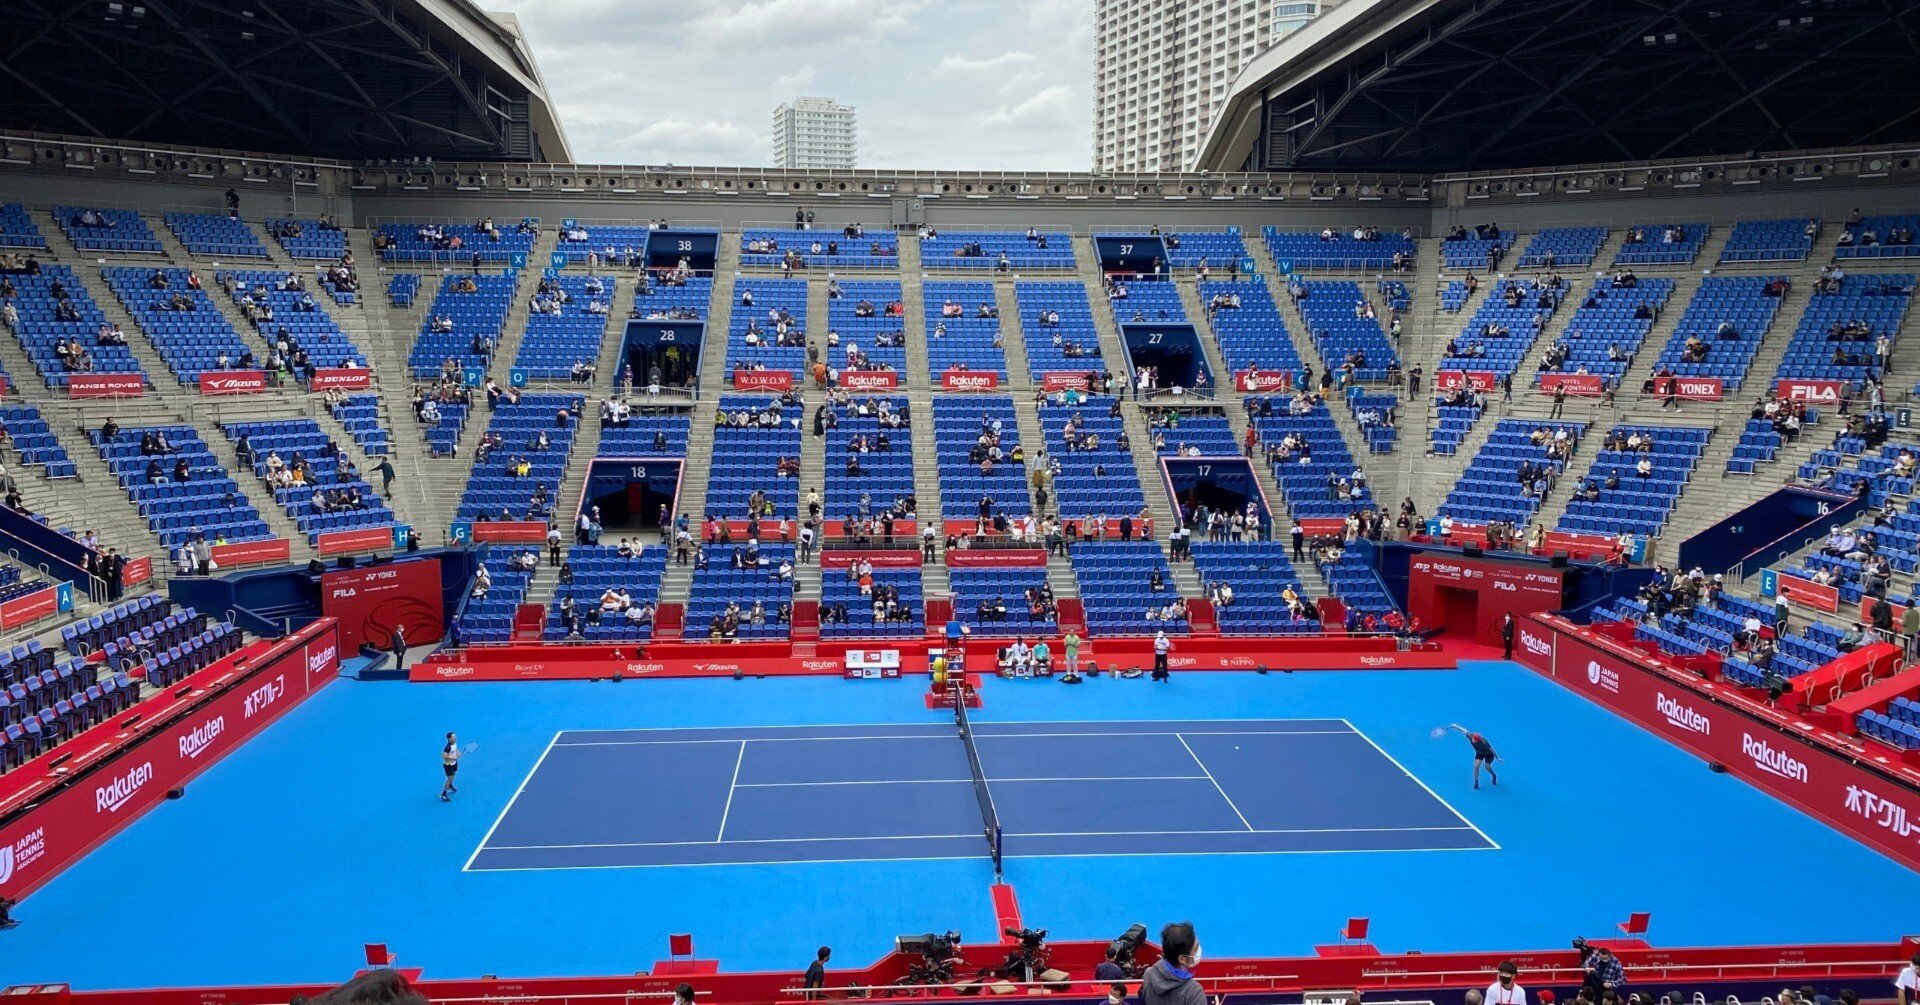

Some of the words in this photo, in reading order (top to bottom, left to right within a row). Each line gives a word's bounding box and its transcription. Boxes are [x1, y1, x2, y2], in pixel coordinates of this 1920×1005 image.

[678, 241, 692, 250] 38
[1120, 245, 1133, 254] 37
[660, 330, 674, 340] 28
[1149, 334, 1163, 343] 27
[470, 373, 476, 381] P
[514, 373, 522, 382] O
[848, 376, 889, 385] Rakuten
[950, 376, 990, 385] Rakuten
[1681, 384, 1715, 395] YONEX
[1791, 386, 1837, 399] FILA
[631, 467, 645, 478] 18
[1197, 465, 1211, 476] 17
[1817, 501, 1829, 515] 16
[399, 531, 407, 541] H
[456, 528, 464, 538] G
[1433, 563, 1461, 572] Rakuten
[377, 571, 397, 579] YONEX
[1537, 575, 1558, 584] YONEX
[1494, 581, 1516, 591] FILA
[1766, 577, 1771, 589] E
[63, 591, 69, 604] A
[333, 588, 356, 598] FILA
[1521, 630, 1551, 656] Rakuten
[310, 646, 335, 671] Rakuten
[1167, 657, 1196, 665] akuten
[1360, 656, 1395, 664] Rakuten
[436, 666, 474, 675] Rakuten
[1601, 668, 1619, 680] JAPAN
[1601, 674, 1619, 689] TENNIS
[244, 674, 284, 719] 木下グループ
[1657, 692, 1710, 735] Rakuten
[178, 715, 224, 759] Rakuten
[1743, 732, 1808, 783] Rakuten
[95, 761, 153, 813] Rakuten
[1845, 784, 1920, 843] 木下グルー
[15, 827, 43, 852] JAPAN
[15, 838, 45, 863] TENNIS
[627, 989, 676, 1000] Barcelo
